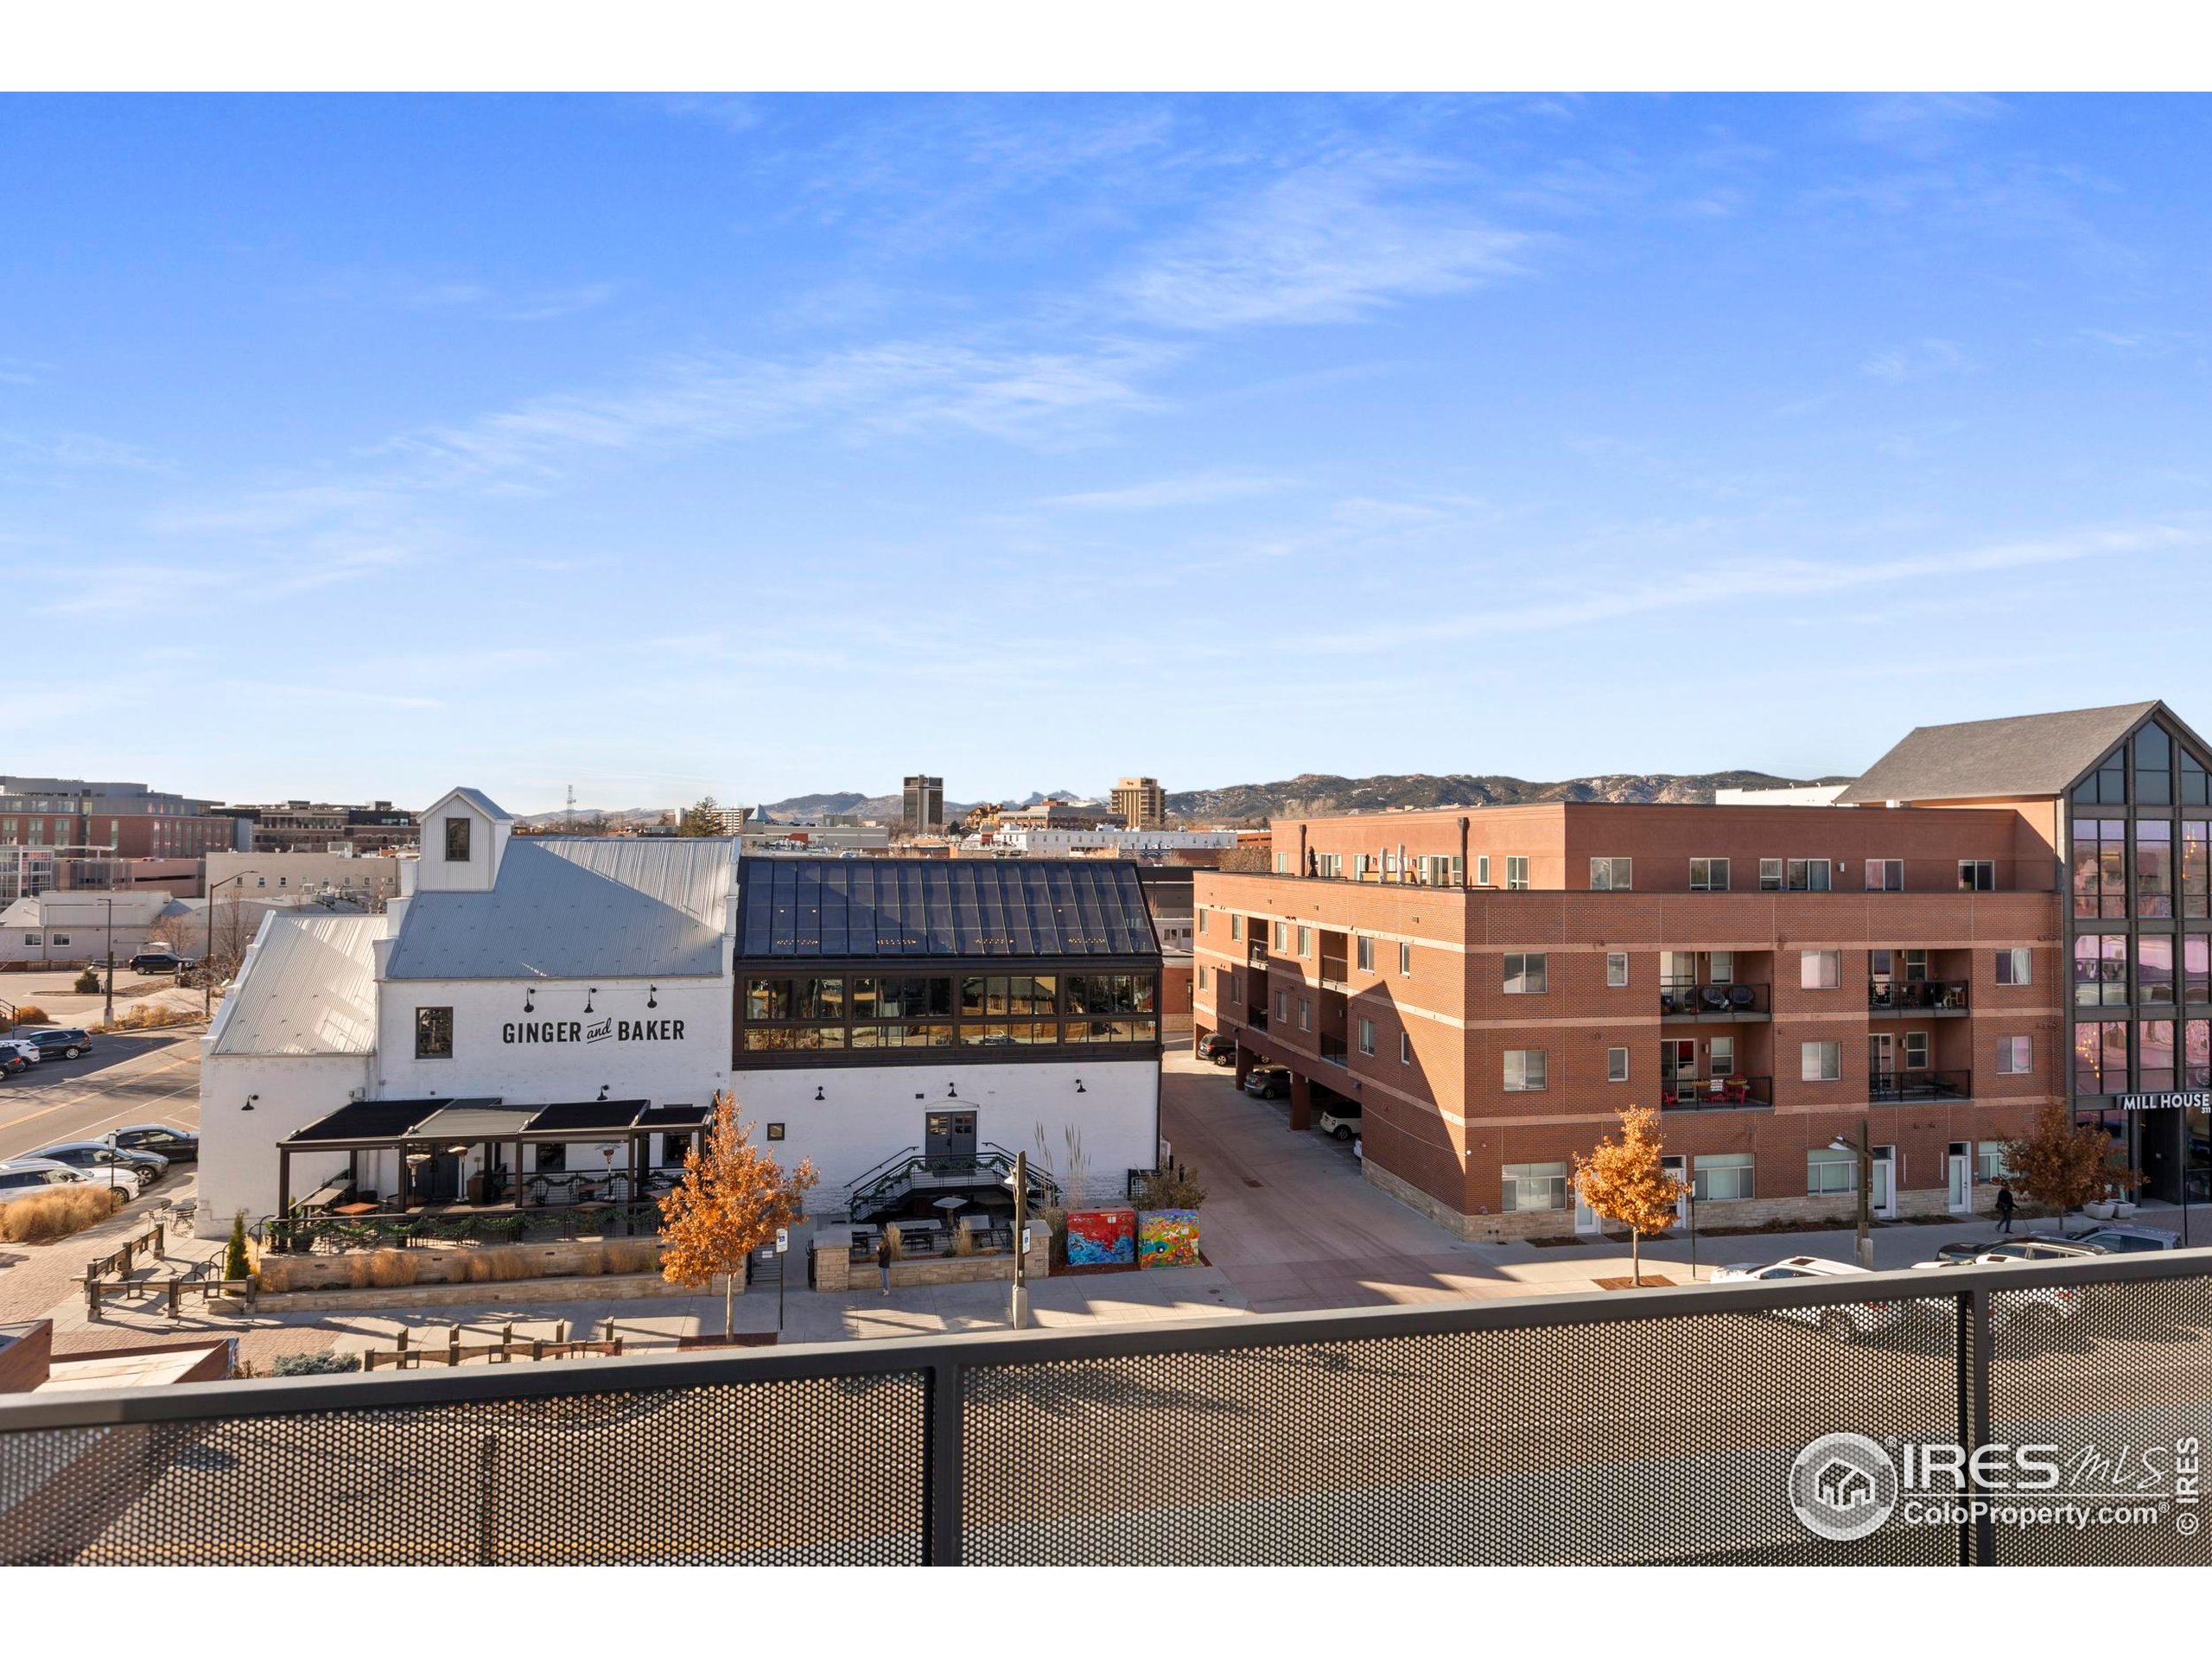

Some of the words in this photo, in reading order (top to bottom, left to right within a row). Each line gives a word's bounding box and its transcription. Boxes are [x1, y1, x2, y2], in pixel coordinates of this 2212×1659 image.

[503, 1022, 582, 1043] GINGER
[587, 1018, 612, 1039] and
[618, 1020, 685, 1041] BAKER
[2124, 1096, 2157, 1109] MILL
[2161, 1093, 2210, 1108] HOUSE
